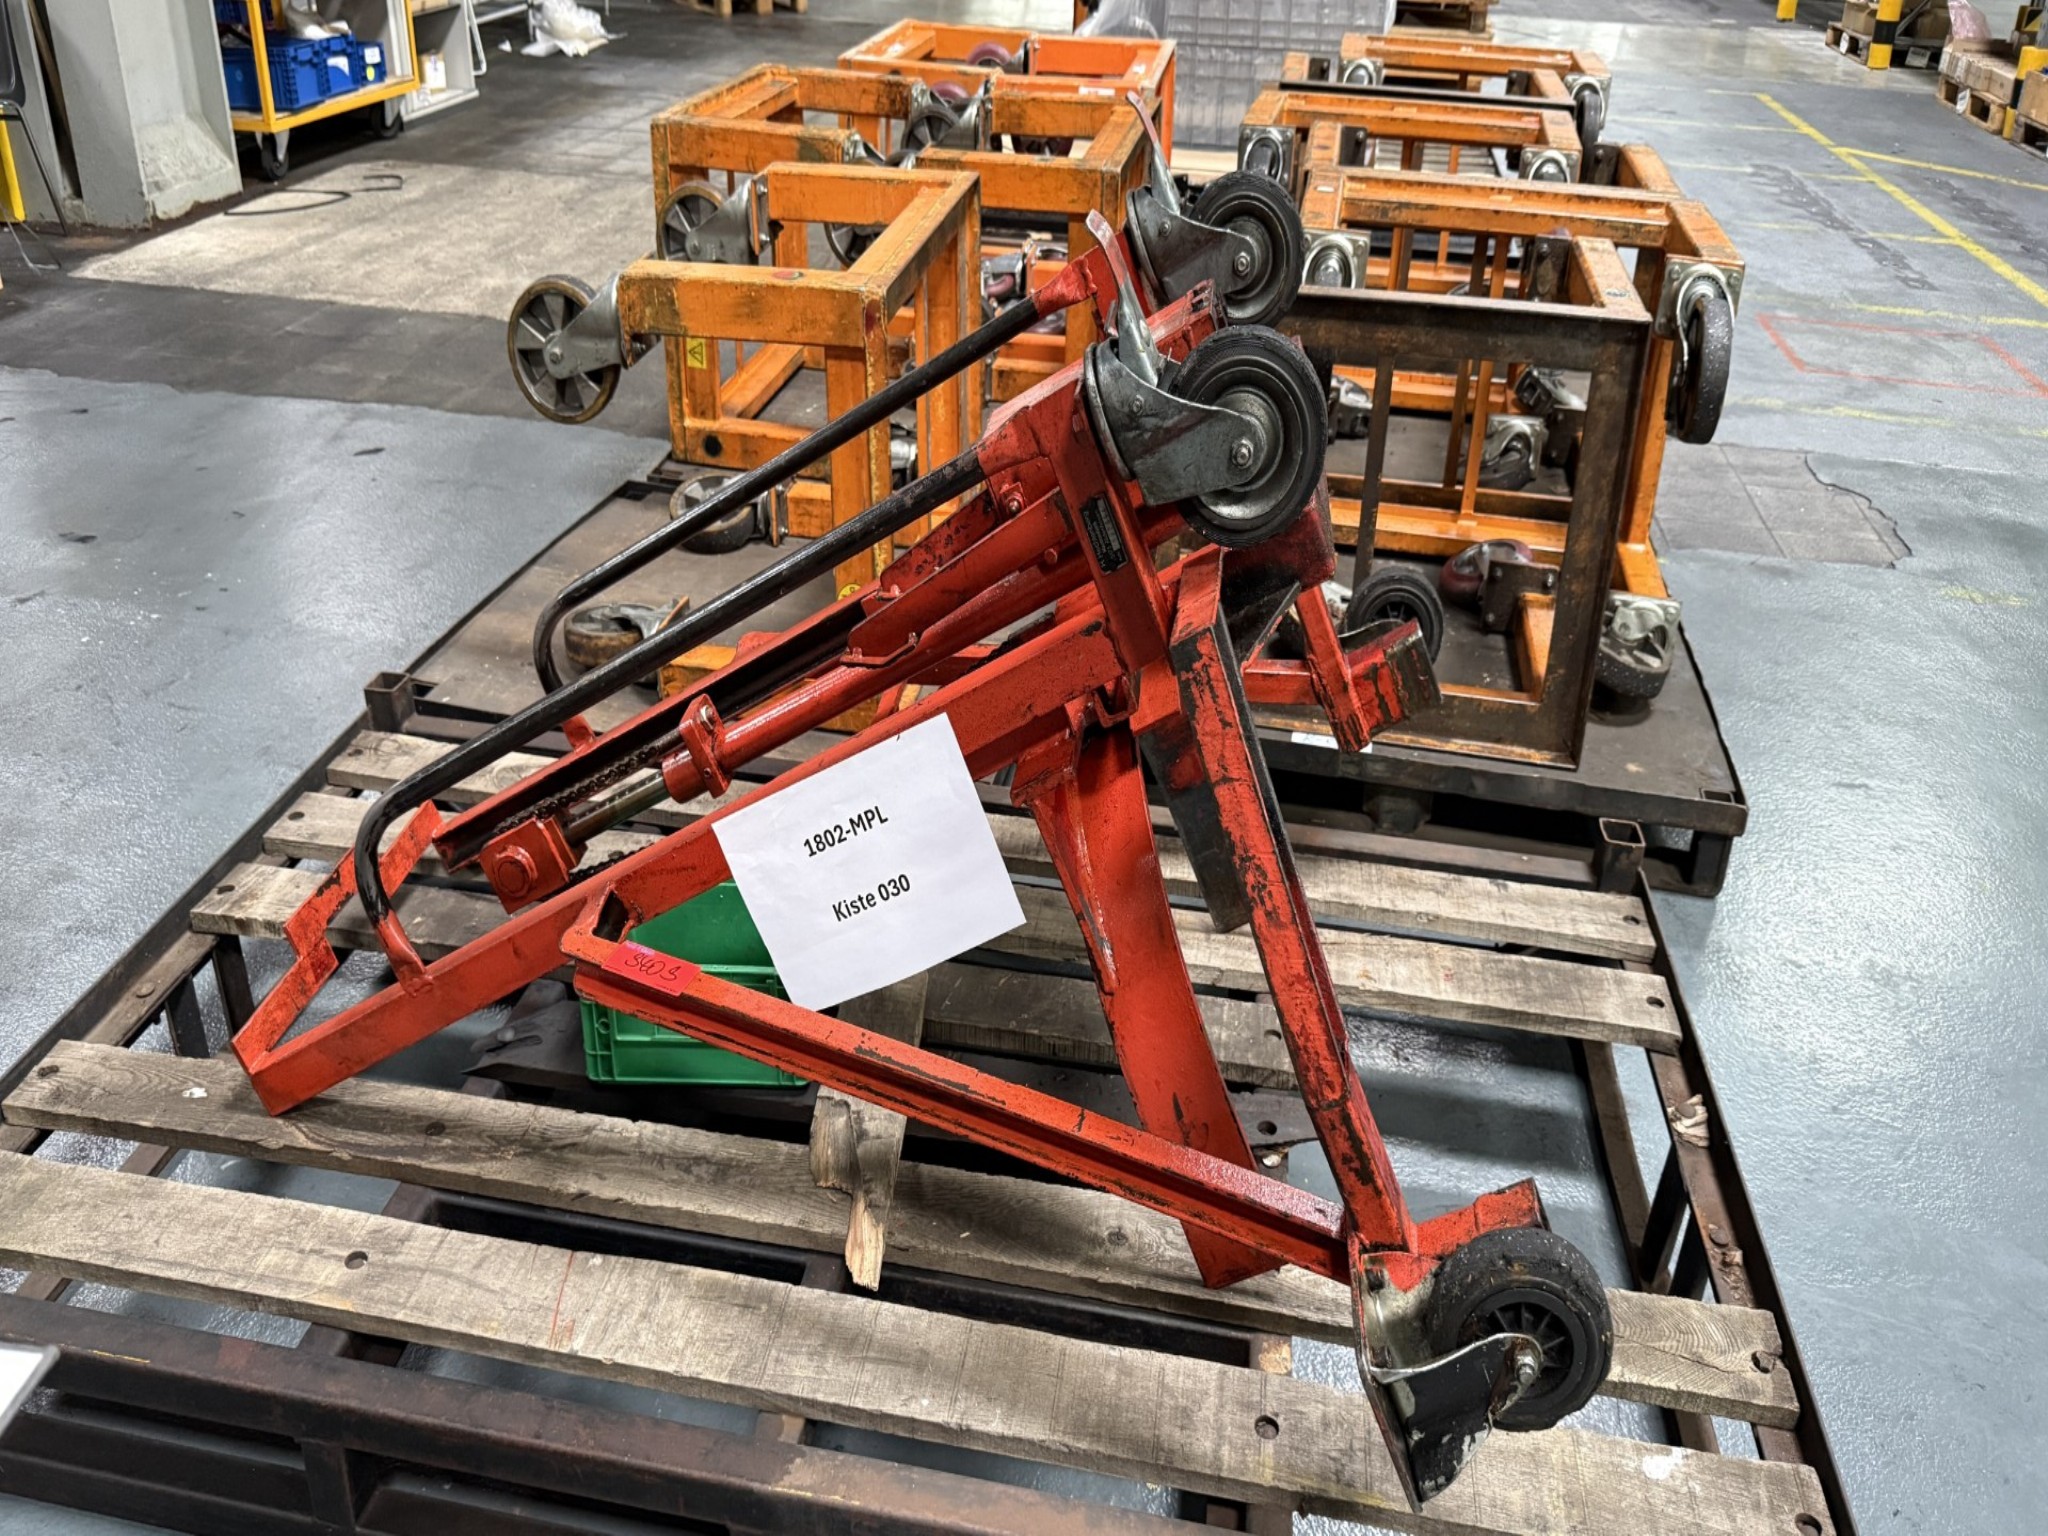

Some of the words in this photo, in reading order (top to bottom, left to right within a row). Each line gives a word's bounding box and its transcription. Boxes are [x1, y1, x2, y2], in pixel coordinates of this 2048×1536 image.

[803, 805, 889, 857] 1802-MPL
[832, 892, 877, 922] Kiste
[877, 874, 911, 901] 030
